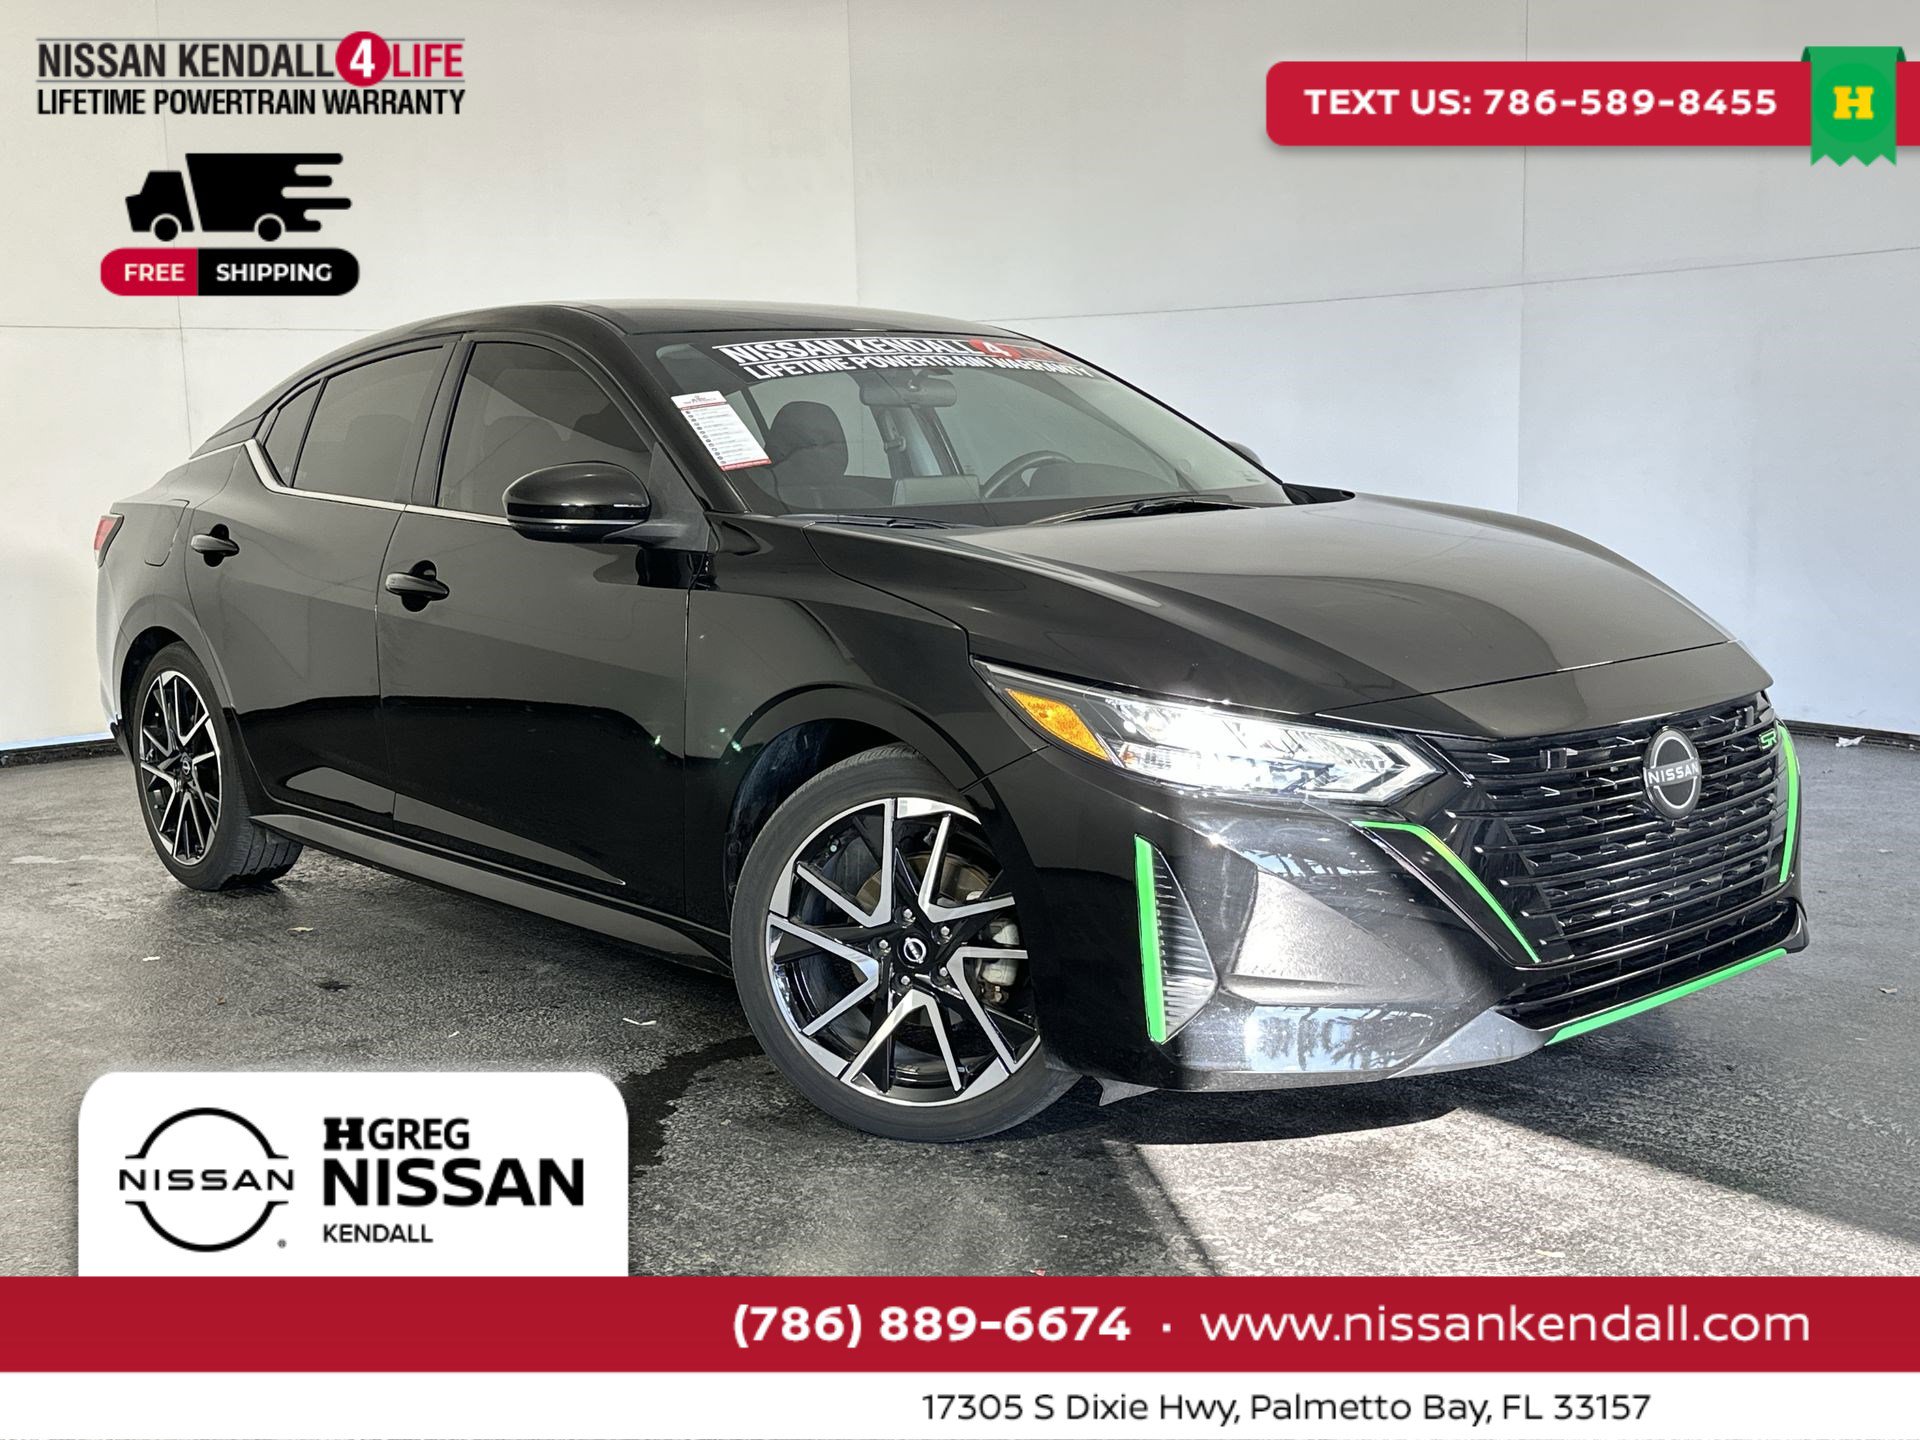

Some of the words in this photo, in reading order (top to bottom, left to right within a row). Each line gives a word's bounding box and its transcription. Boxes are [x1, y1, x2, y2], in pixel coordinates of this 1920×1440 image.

[719, 338, 856, 363] NISSAN
[844, 338, 985, 355] KENDALL
[982, 341, 1013, 358] 4
[743, 356, 857, 380] LIFETIME
[848, 354, 995, 370] POWERTRAIN
[1648, 761, 1699, 784] NISSAN
